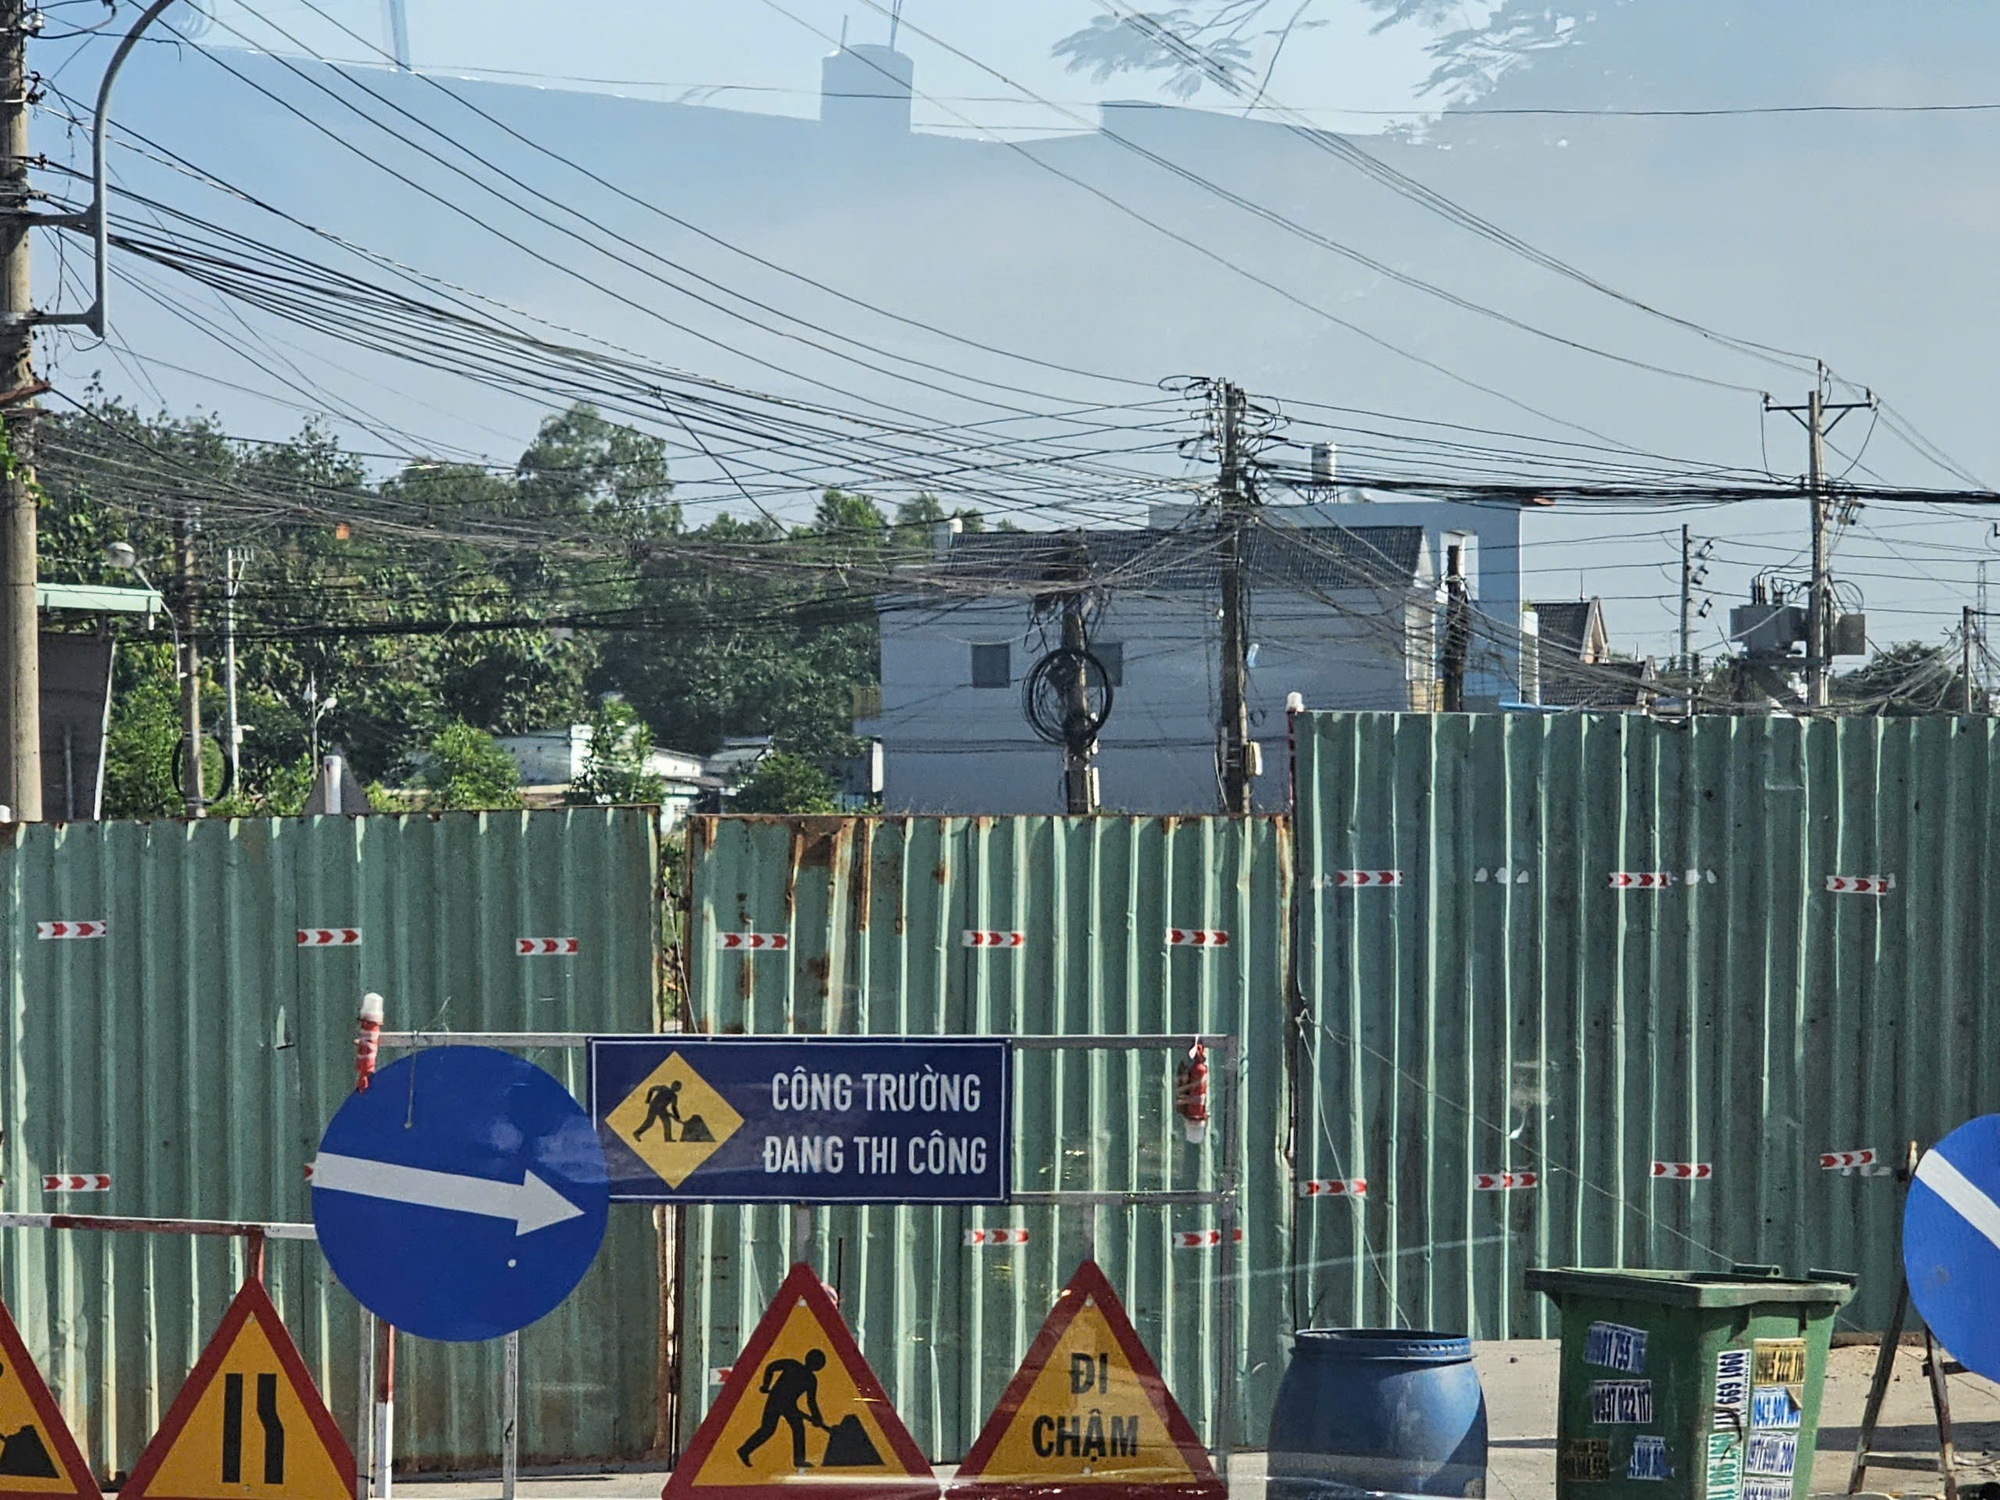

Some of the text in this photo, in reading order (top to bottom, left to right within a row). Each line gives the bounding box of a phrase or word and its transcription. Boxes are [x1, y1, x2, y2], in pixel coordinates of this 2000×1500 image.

[772, 1064, 981, 1112] CÔNG TRƯỜNG
[762, 1129, 987, 1174] ĐANG THI CÔNG
[1069, 1352, 1108, 1396] ĐI
[1031, 1410, 1139, 1462] CHẬM
